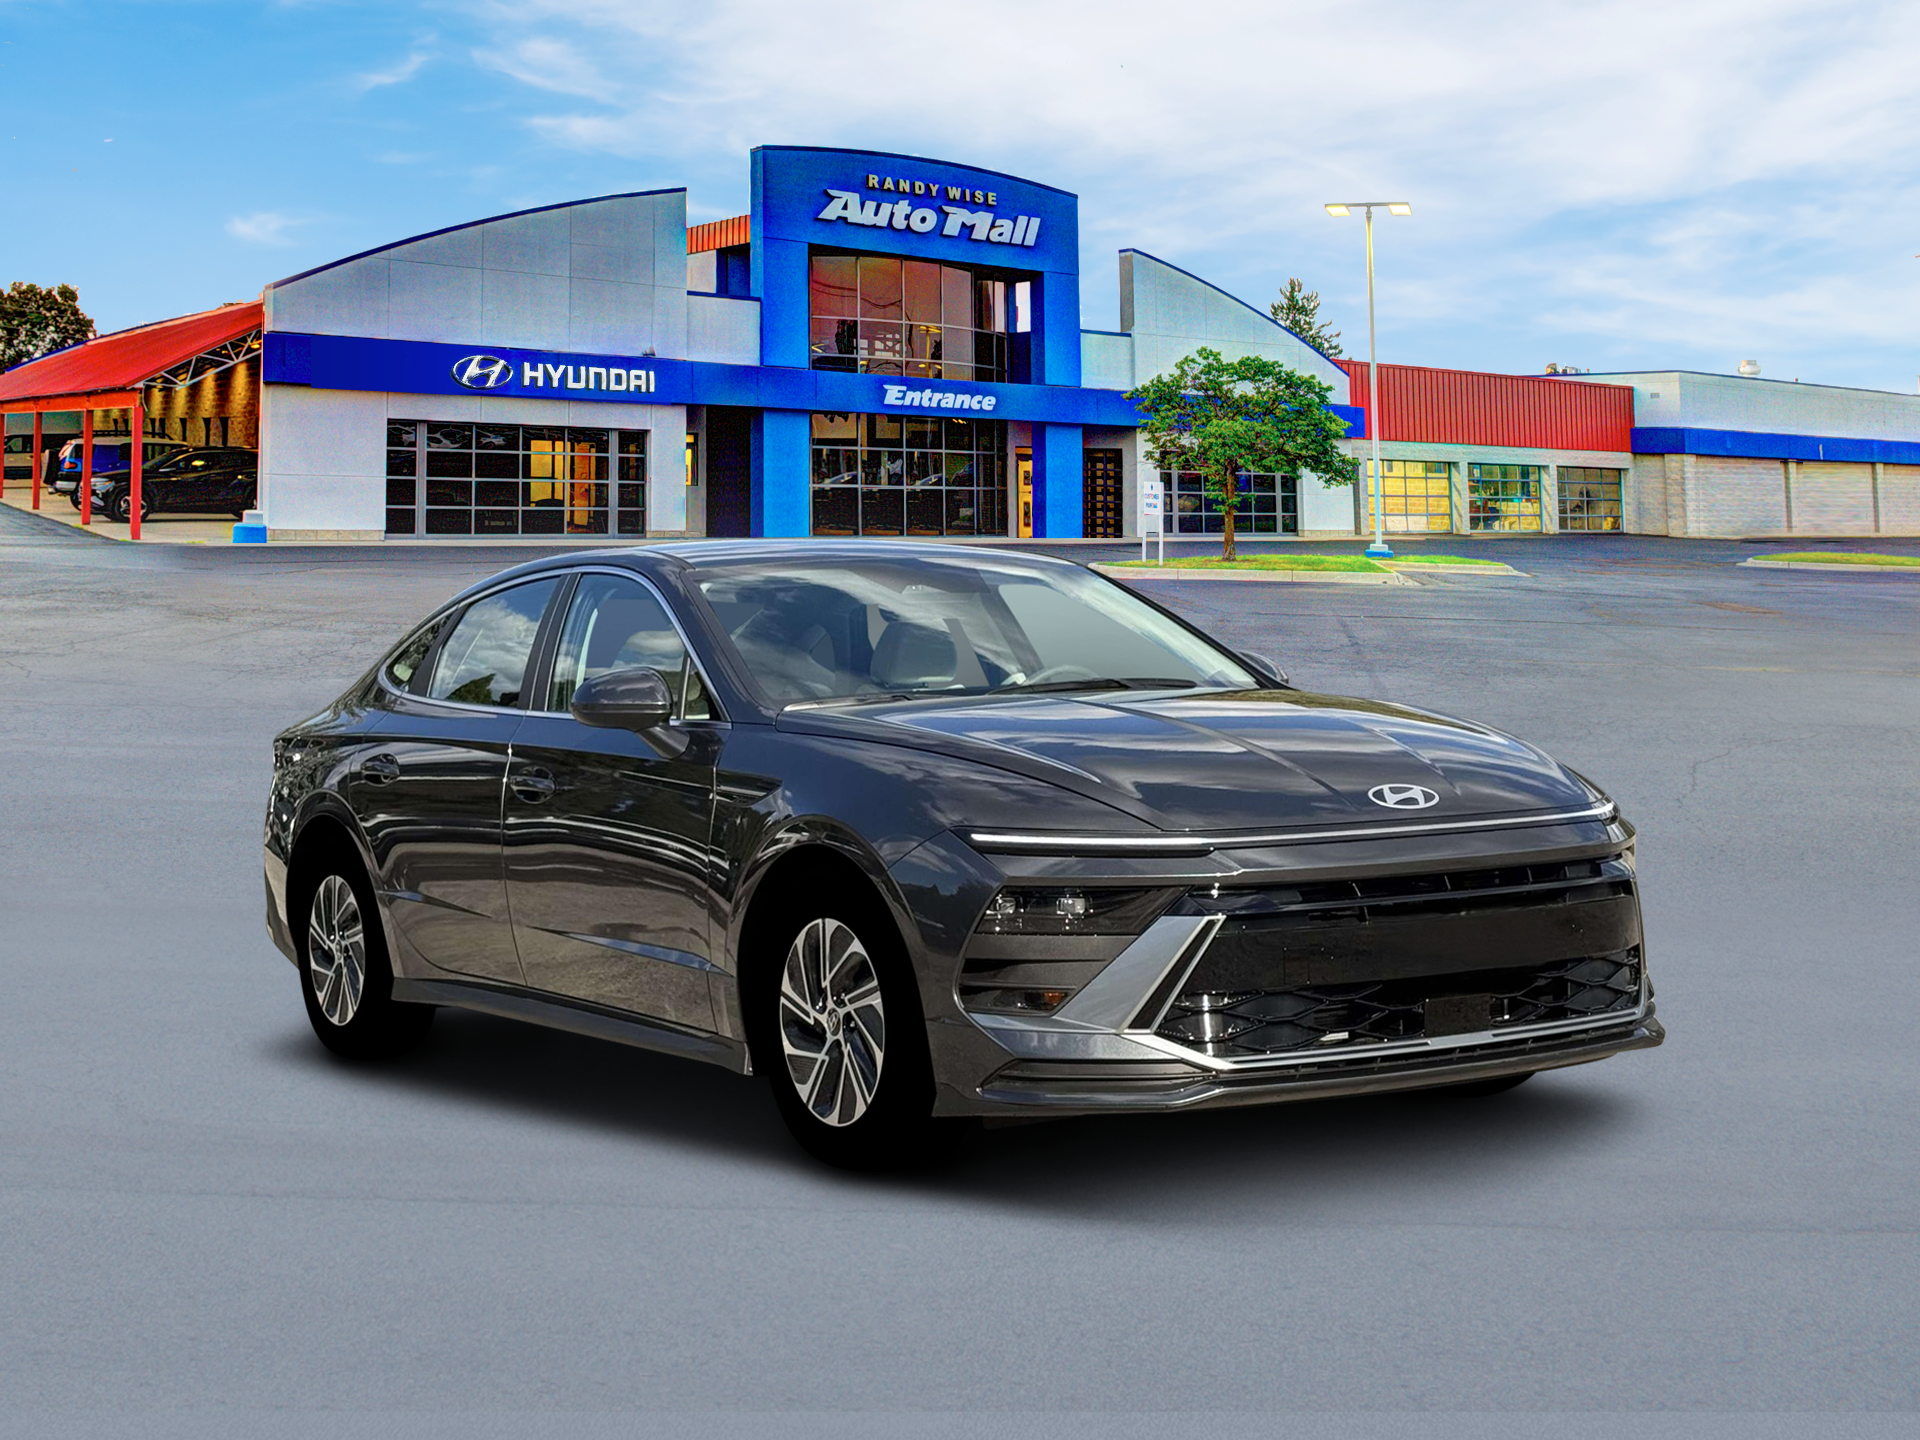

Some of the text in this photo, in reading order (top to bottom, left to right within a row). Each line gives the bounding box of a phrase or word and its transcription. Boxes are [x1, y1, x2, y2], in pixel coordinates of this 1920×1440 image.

[867, 174, 997, 206] RANDY WISE
[816, 189, 1041, 247] Auto Mall
[522, 362, 655, 393] HYUNDAI
[883, 384, 996, 410] Entrance
